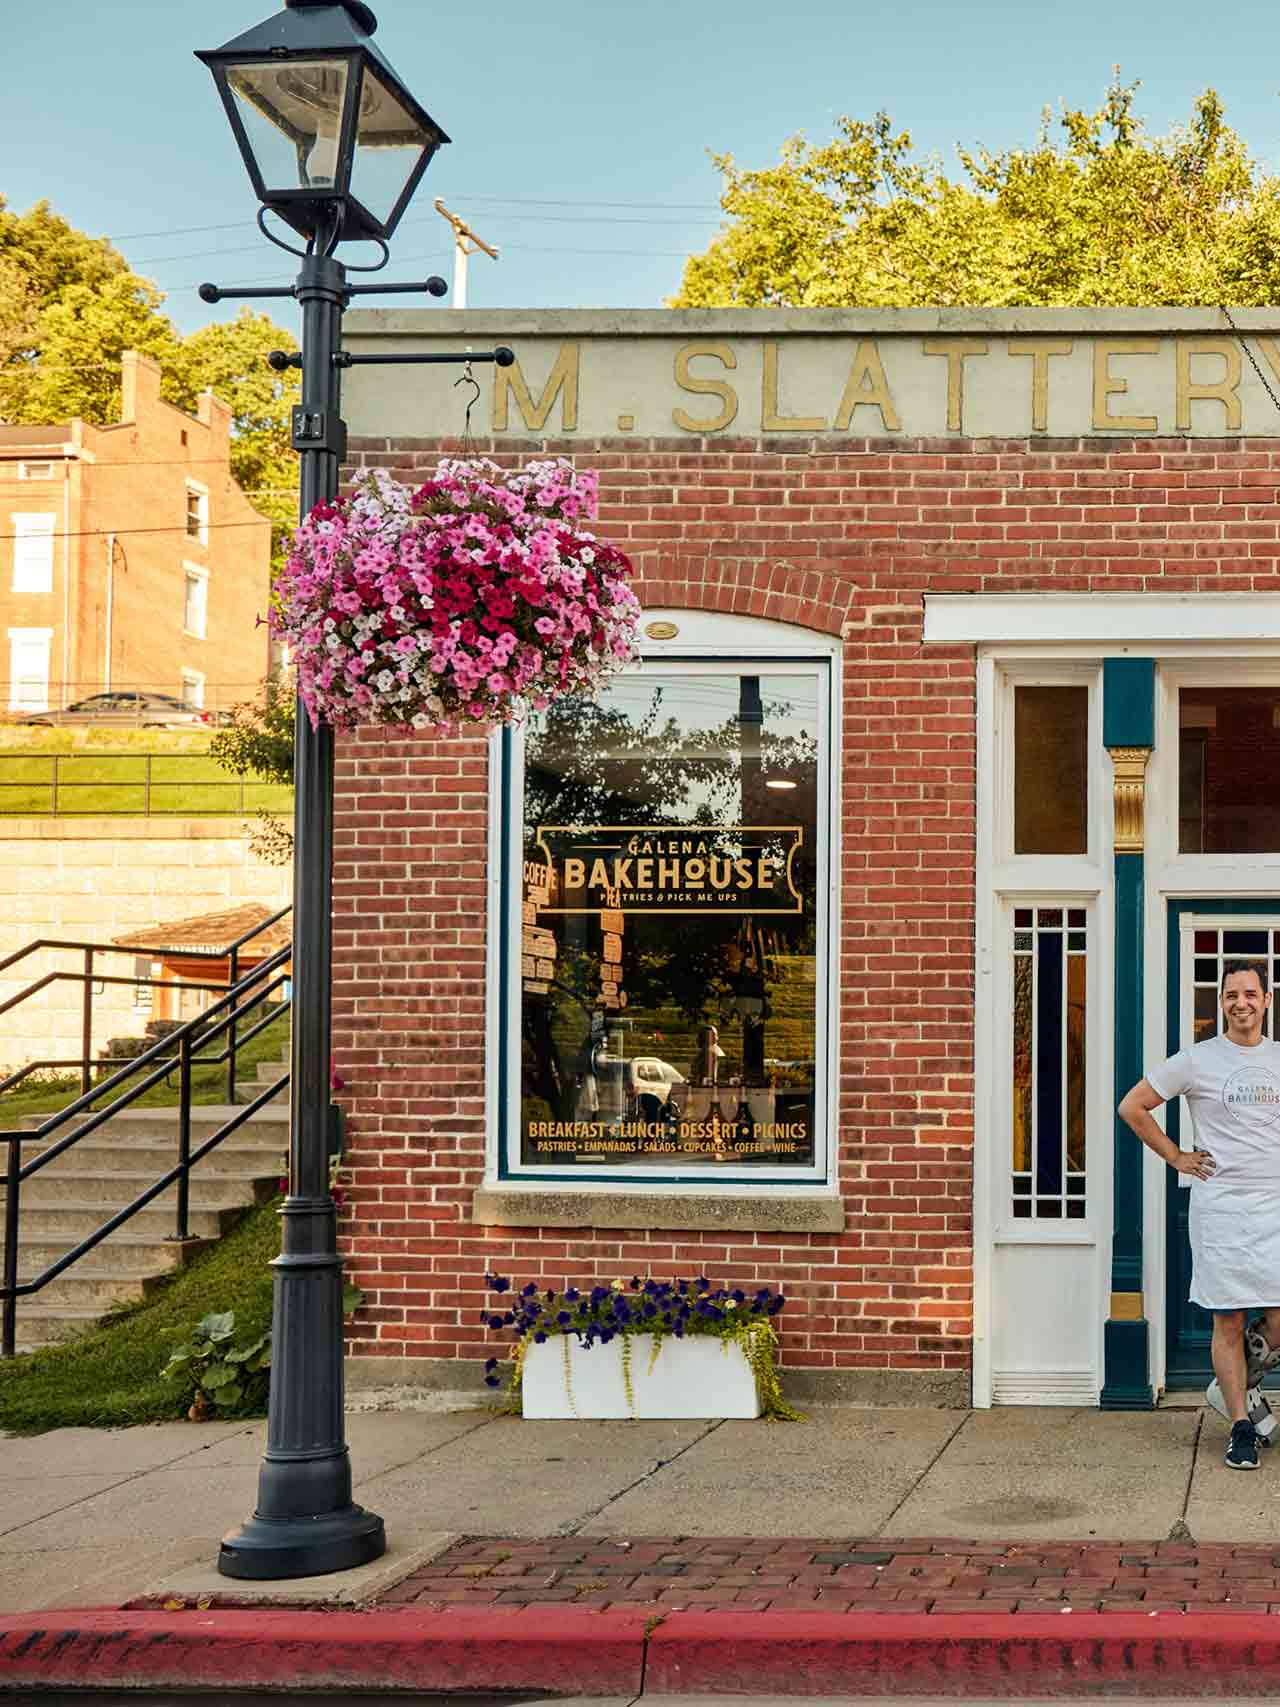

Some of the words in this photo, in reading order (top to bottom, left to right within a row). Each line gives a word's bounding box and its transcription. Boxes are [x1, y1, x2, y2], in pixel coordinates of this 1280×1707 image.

[628, 841, 707, 855] GALENA
[564, 858, 774, 889] BAKEHOUSE
[600, 893, 653, 902] PTRIES
[668, 893, 691, 902] PICK
[697, 893, 713, 902] ME
[718, 893, 737, 902] UPS
[528, 1121, 606, 1138] BREAKFAST
[620, 1121, 665, 1137] LUNCH
[680, 1121, 738, 1138] DESSERT
[753, 1122, 806, 1139] PICNICS
[537, 1141, 576, 1152] PASTRIES
[584, 1141, 636, 1152] EMPANADAS
[643, 1141, 676, 1152] SALADS
[683, 1142, 727, 1153] CUPCAKES
[772, 1143, 796, 1153] WINE
